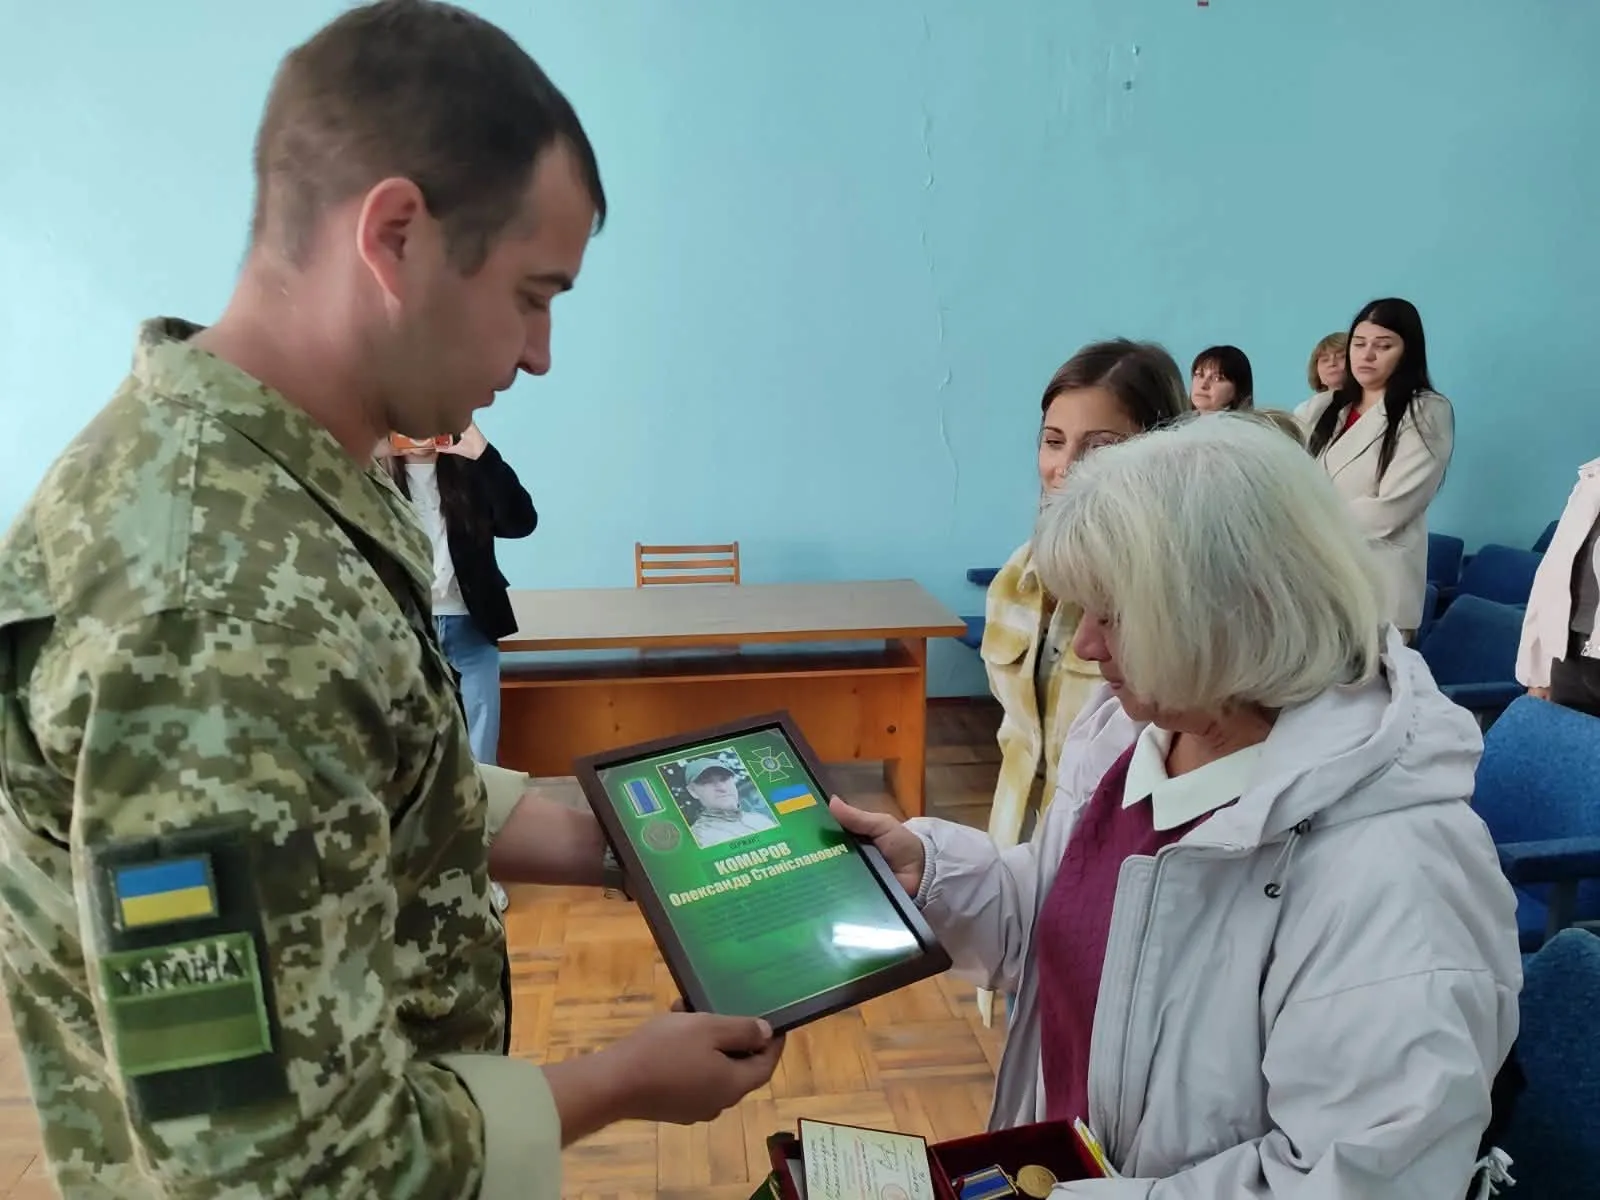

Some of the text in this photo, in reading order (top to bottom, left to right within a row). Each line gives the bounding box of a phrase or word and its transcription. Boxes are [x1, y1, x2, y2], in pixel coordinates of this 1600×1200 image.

[668, 874, 751, 906] Олександр
[750, 843, 848, 880] Станіславович
[714, 842, 791, 875] КОМАРОВ
